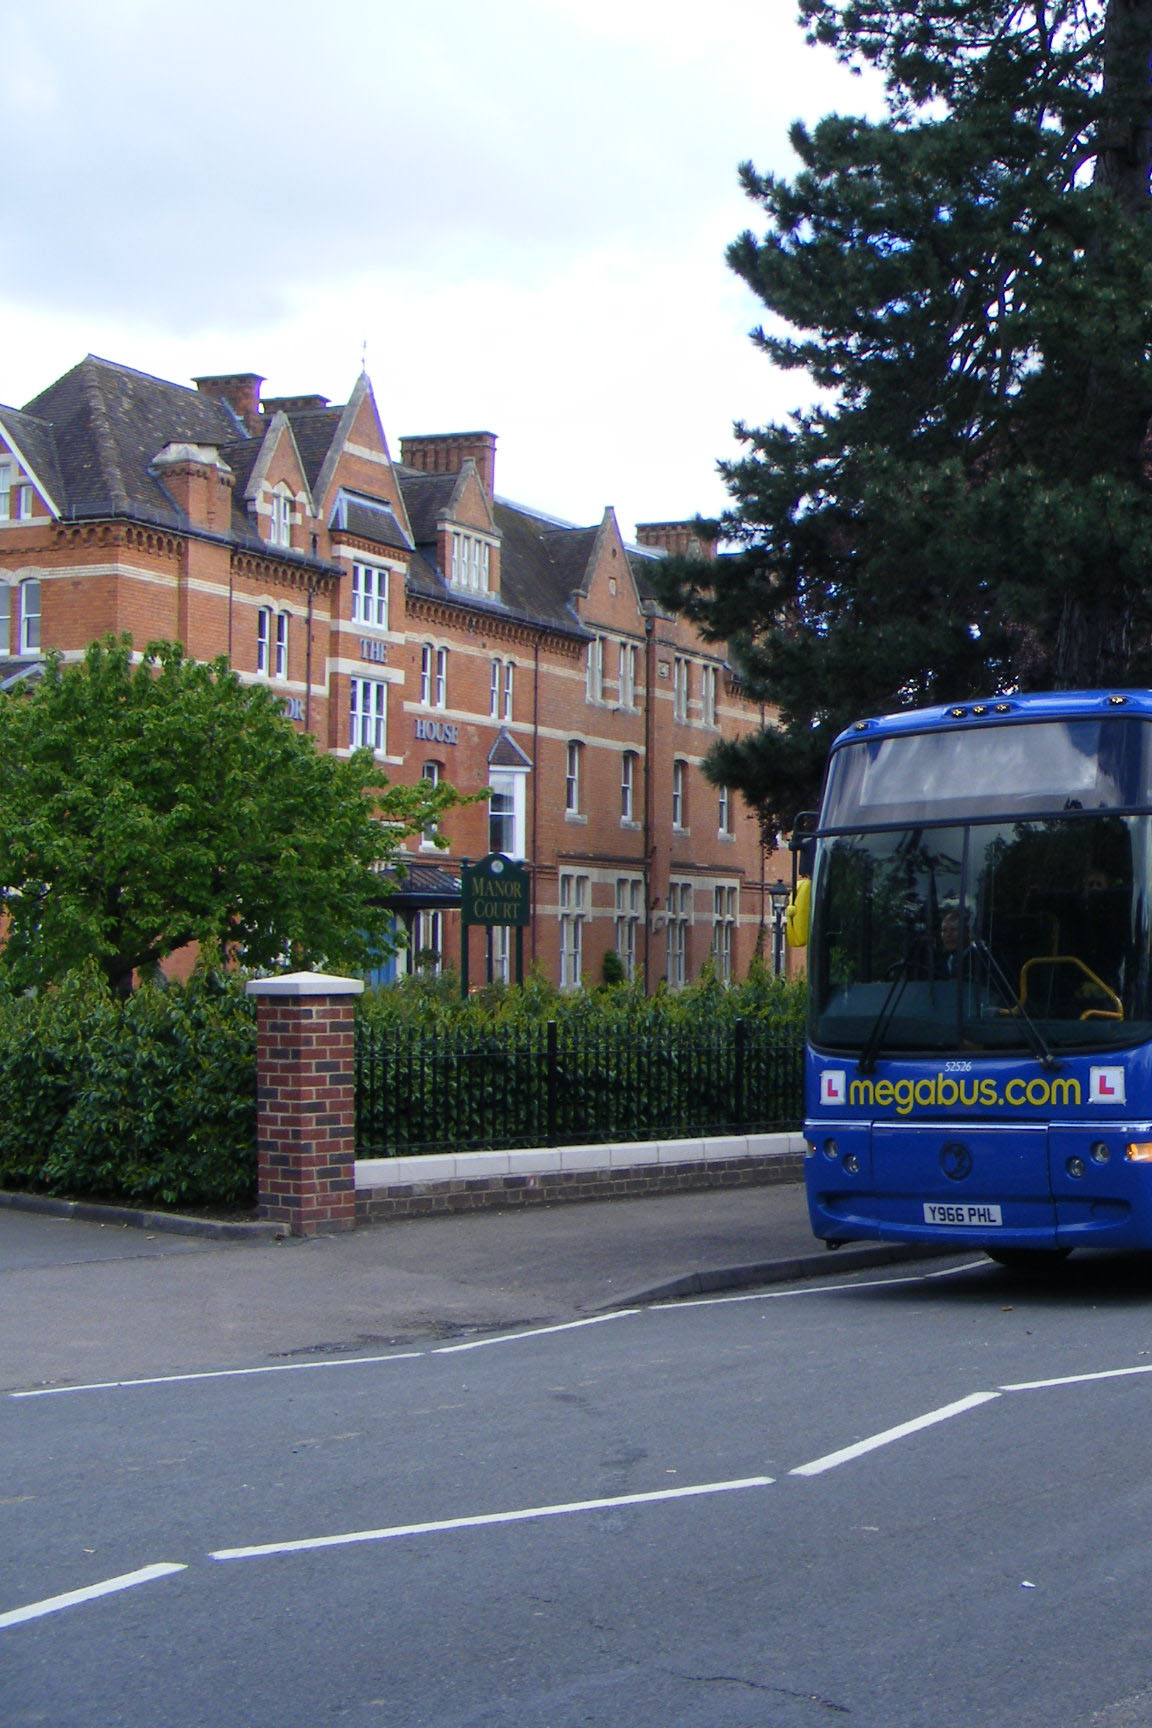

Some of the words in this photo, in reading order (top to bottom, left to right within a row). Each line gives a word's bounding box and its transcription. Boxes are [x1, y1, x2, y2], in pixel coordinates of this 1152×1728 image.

[359, 638, 388, 663] THE
[414, 719, 459, 745] HOUSE
[471, 876, 522, 898] MANOR
[473, 899, 520, 919] COURT
[944, 1061, 973, 1072] 52526
[827, 1079, 839, 1097] L
[849, 1072, 1081, 1115] megabus.com
[1099, 1075, 1115, 1095] L
[928, 1206, 965, 1222] Y966
[967, 1207, 997, 1223] PHL
